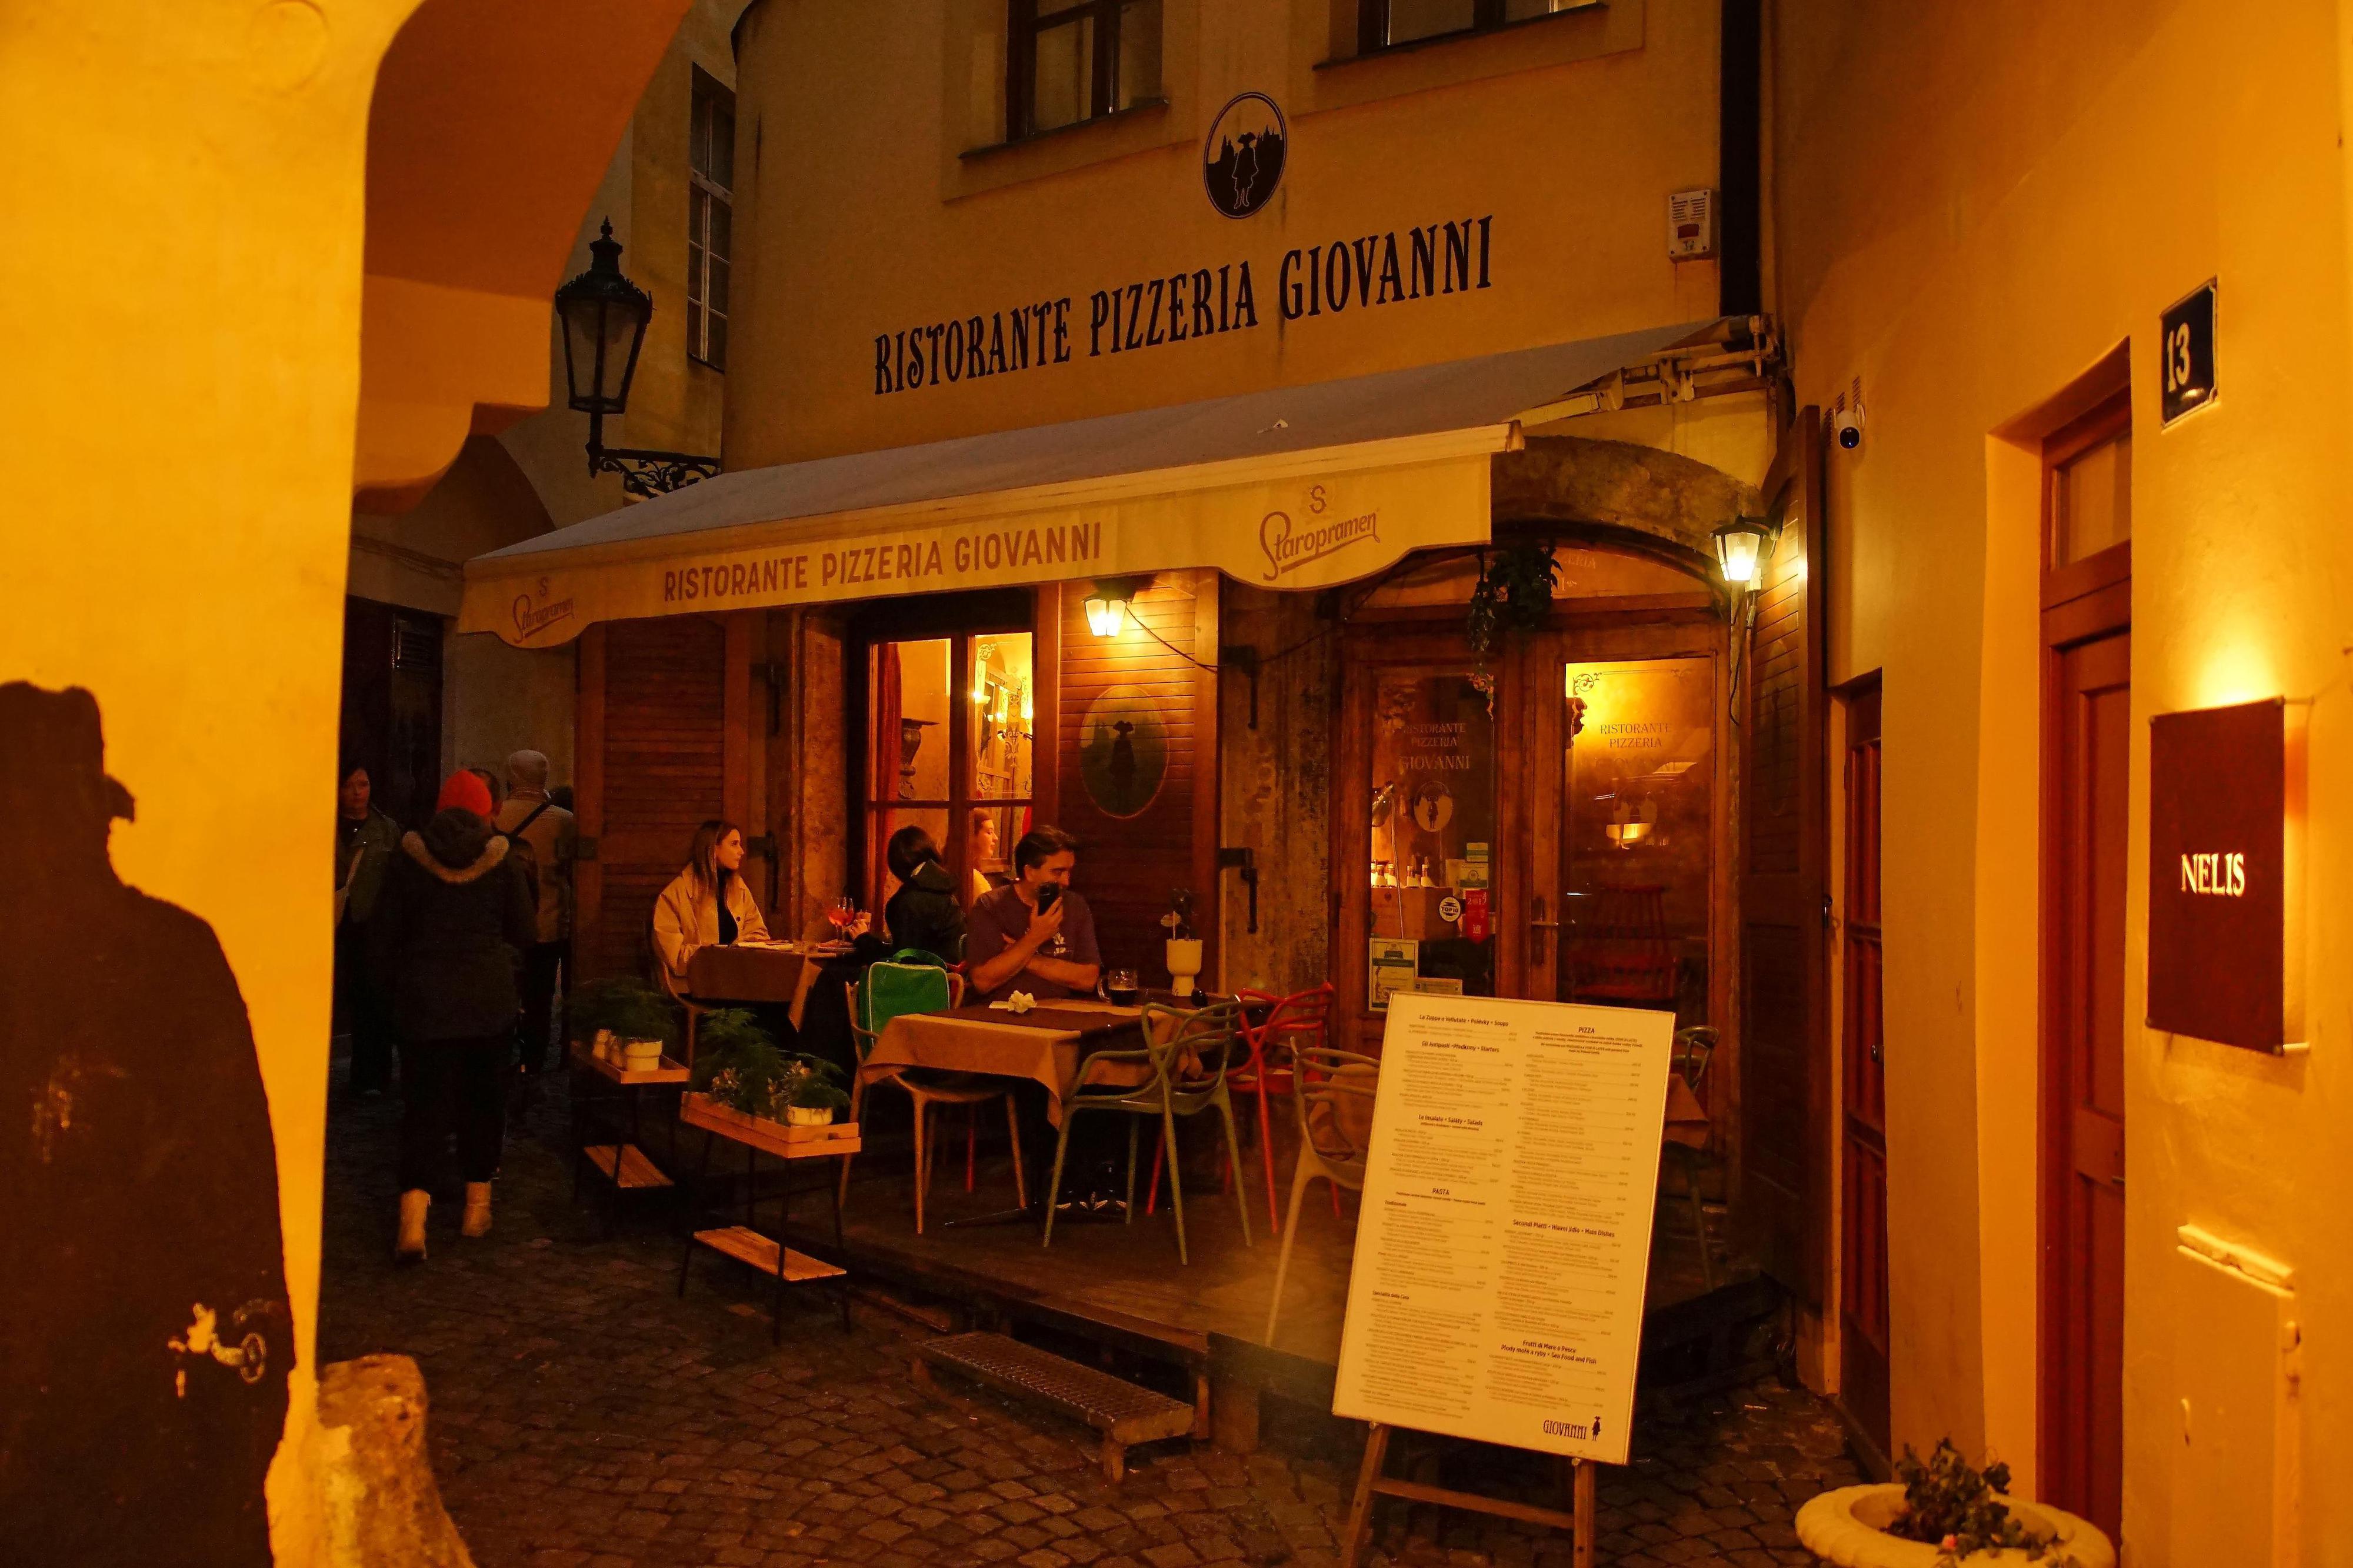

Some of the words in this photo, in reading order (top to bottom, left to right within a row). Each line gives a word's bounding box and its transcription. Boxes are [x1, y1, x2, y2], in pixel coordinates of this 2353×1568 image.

[875, 297, 1070, 395] RISTORANTE
[1090, 261, 1258, 357] PIZZERIA
[1279, 215, 1492, 320] GIOVANNI
[2167, 322, 2191, 393] 13
[1308, 485, 1327, 514] S
[1259, 511, 1381, 581] Staropramen
[664, 555, 809, 602] RISTORANTE
[824, 541, 944, 587] PIZZERIA
[954, 521, 1102, 573] GIOVANNI
[512, 593, 575, 644] Staropramen
[1609, 737, 1662, 748] PIZZERIA
[2181, 852, 2245, 898] NELIS
[1432, 1187, 1450, 1196] PASTA
[1533, 1221, 1547, 1229] Piatti
[1522, 1340, 1537, 1348] Frutti
[1561, 1353, 1575, 1362] Food
[1542, 1419, 1588, 1440] GIOVANNI
